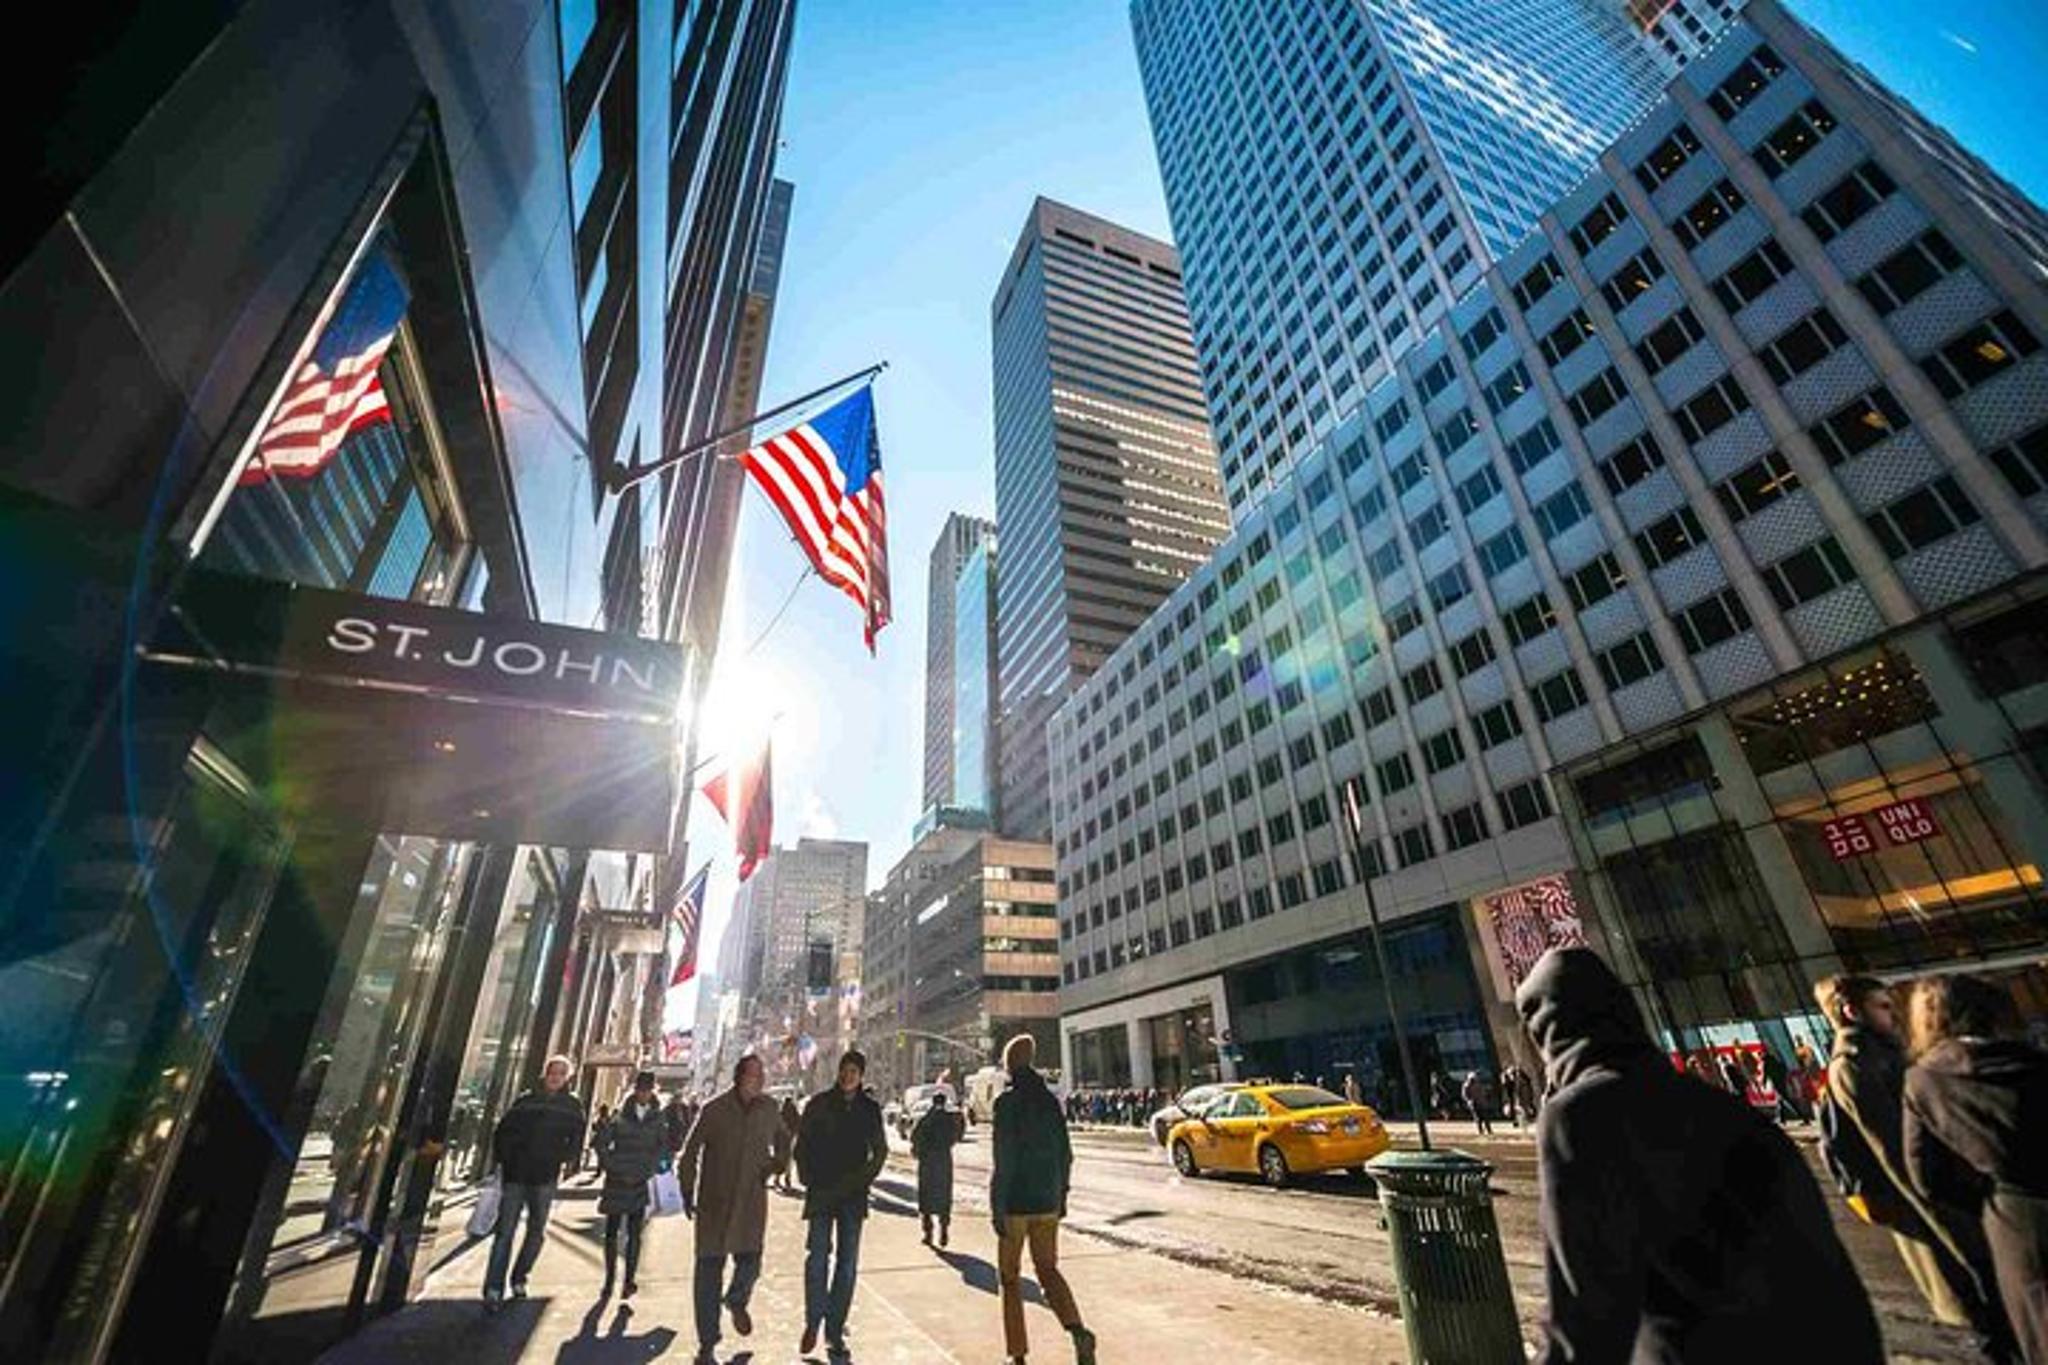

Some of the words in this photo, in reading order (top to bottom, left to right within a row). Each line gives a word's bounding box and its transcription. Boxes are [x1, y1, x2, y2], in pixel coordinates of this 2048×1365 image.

[327, 617, 430, 661] ST.
[444, 637, 656, 691] JOHN
[1880, 803, 1920, 825] UNI
[1890, 818, 1932, 842] QLO
